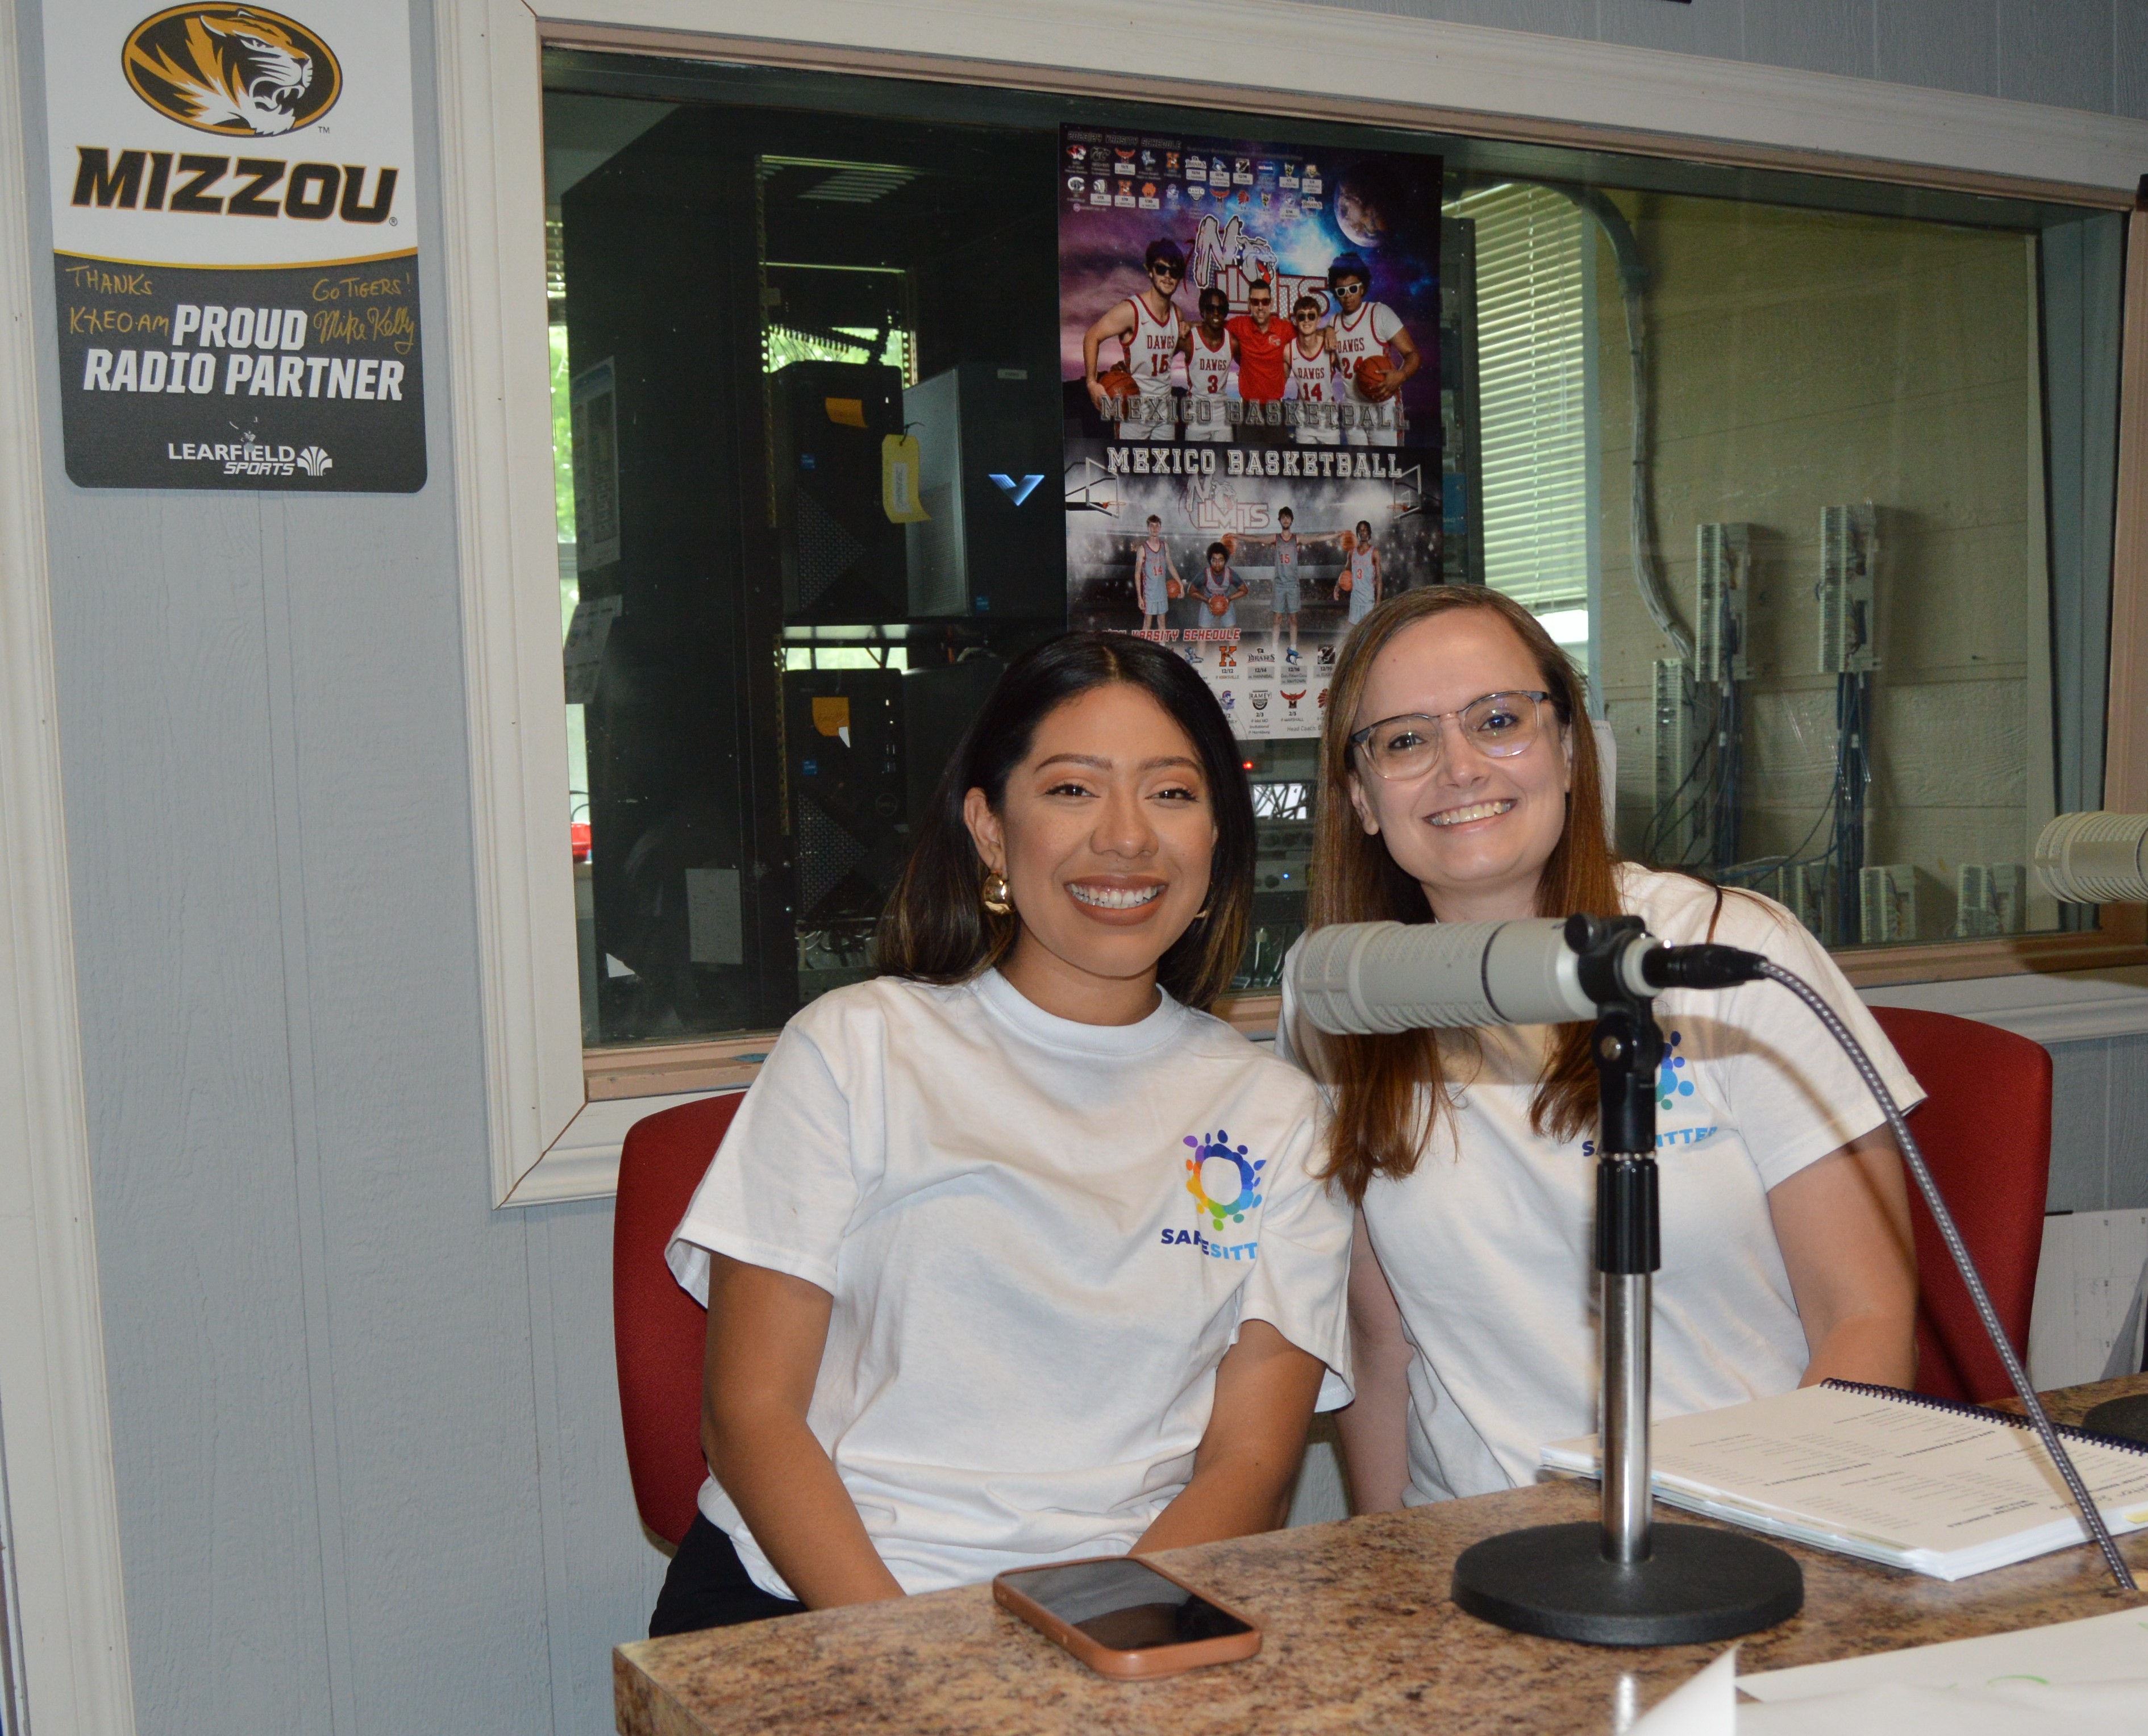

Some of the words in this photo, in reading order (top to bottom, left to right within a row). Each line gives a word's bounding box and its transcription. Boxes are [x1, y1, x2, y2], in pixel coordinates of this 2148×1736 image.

[69, 145, 399, 225] MIZZOU
[65, 265, 153, 296] THANKS
[172, 304, 309, 351] PROUD
[1147, 335, 1175, 349] DAWGS
[1338, 338, 1365, 353] DAWGS
[1199, 358, 1227, 371] DAWGS
[83, 348, 217, 395] RADIO
[224, 353, 405, 401] PARTNER
[1298, 367, 1325, 380] DAWGS
[1207, 374, 1218, 394] 3
[1303, 383, 1323, 401] 14
[1100, 396, 1214, 424] MEXICO
[1225, 399, 1410, 430] BASKETBALL
[168, 443, 296, 463] LEARFIELD
[223, 461, 295, 476] SPORTS
[1107, 447, 1216, 474] MEXICO
[1227, 449, 1402, 478] BASKETBALL
[1280, 553, 1291, 564] 15
[1153, 566, 1163, 576] 14
[1356, 568, 1363, 579] 3
[1131, 629, 1180, 643] VARSITY
[1183, 628, 1242, 642] SCHEDULE
